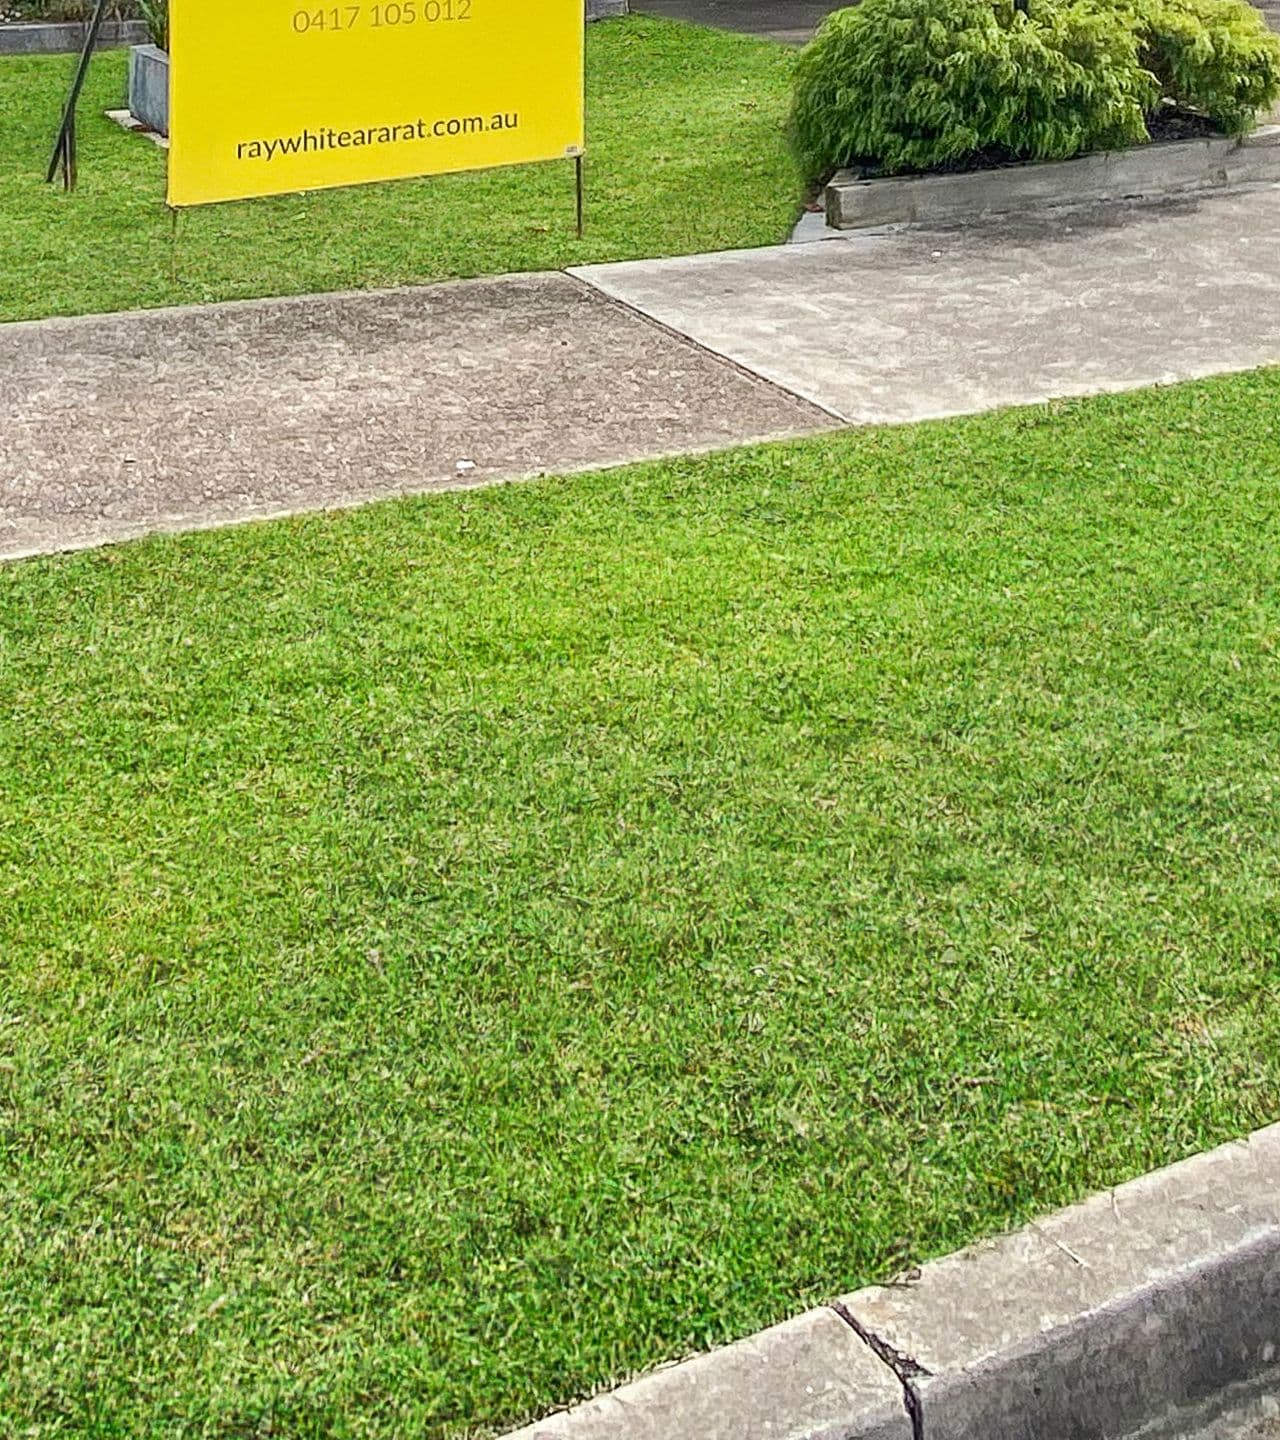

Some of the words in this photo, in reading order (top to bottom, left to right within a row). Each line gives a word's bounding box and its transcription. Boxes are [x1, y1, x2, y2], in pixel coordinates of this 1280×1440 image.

[293, 7, 361, 33] 0417
[371, 2, 416, 27] 105
[237, 111, 518, 161] raywhiteararat.com.au
